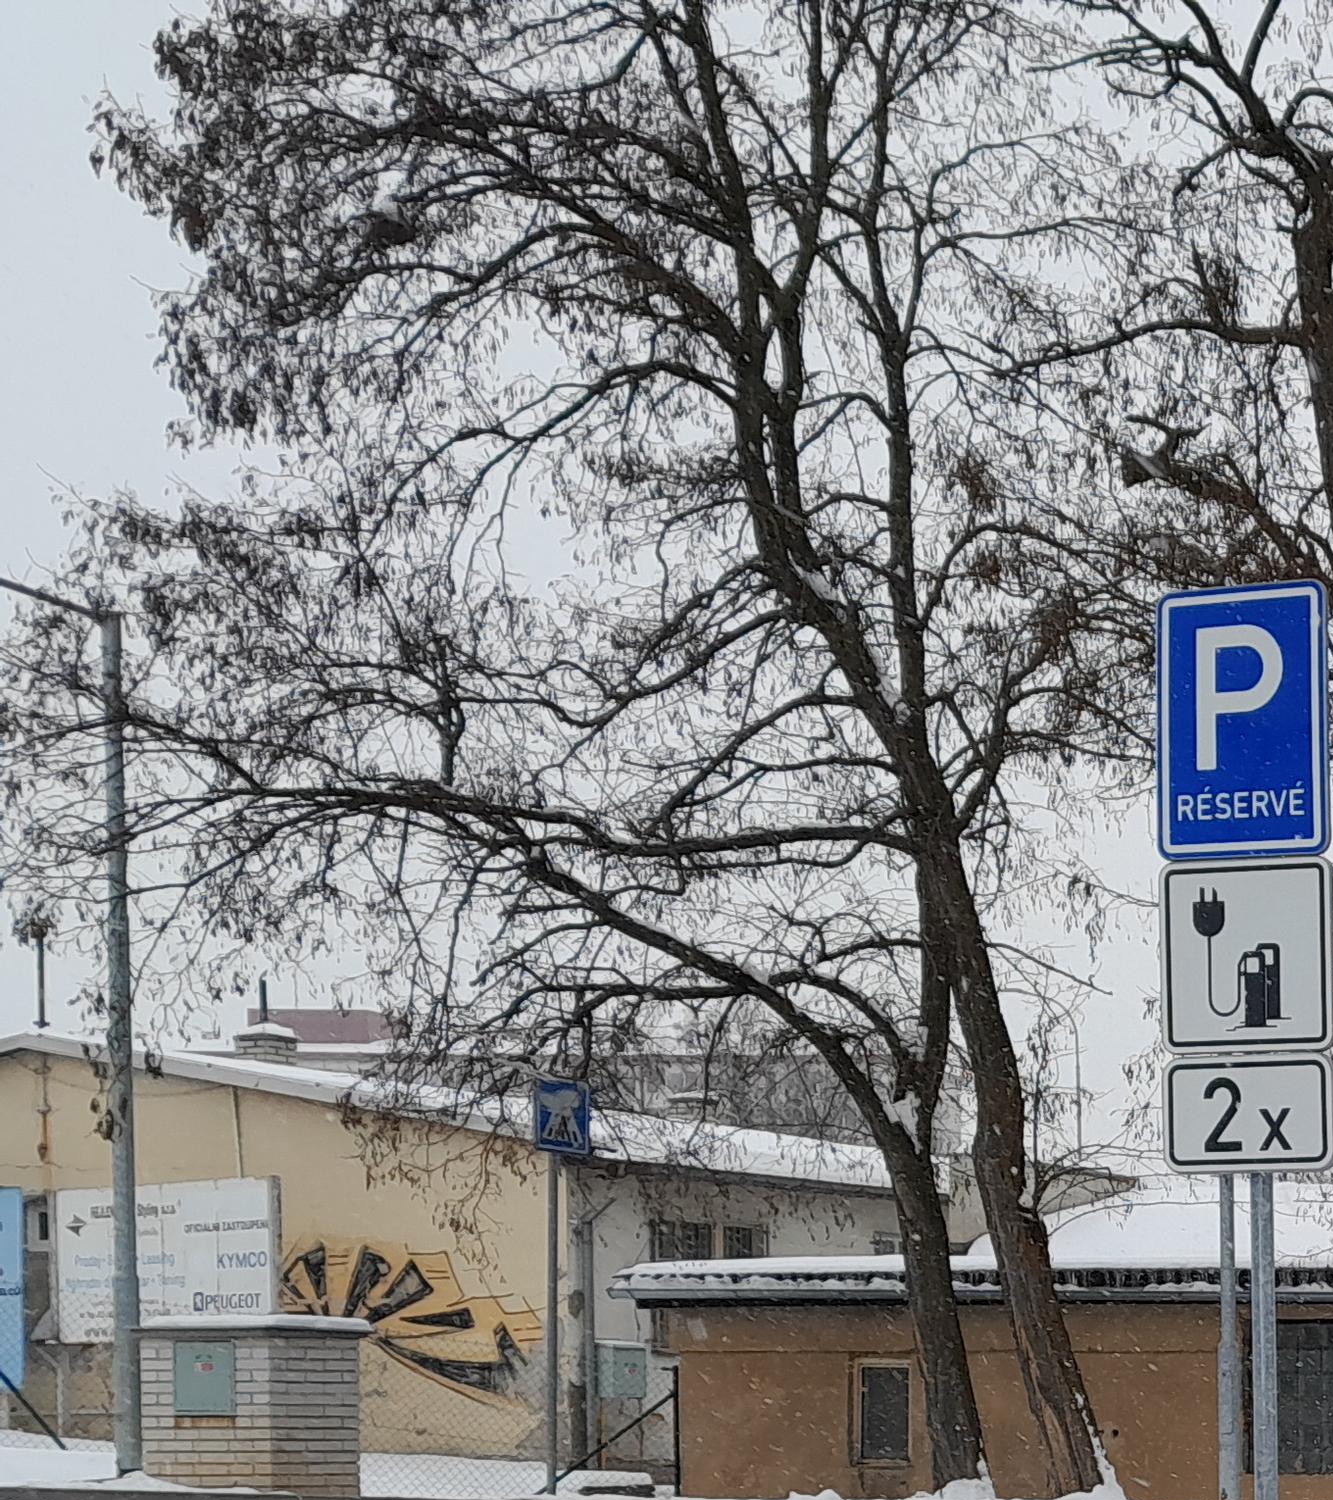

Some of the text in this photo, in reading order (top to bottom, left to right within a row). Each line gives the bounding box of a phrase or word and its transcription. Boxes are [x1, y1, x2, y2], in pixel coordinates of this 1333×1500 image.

[1195, 623, 1284, 771] P
[1177, 781, 1305, 821] RÉSERVÉ
[1203, 1076, 1293, 1153] 2 x
[217, 1251, 267, 1269] KYMCO
[205, 1292, 262, 1311] PEUGEOT
